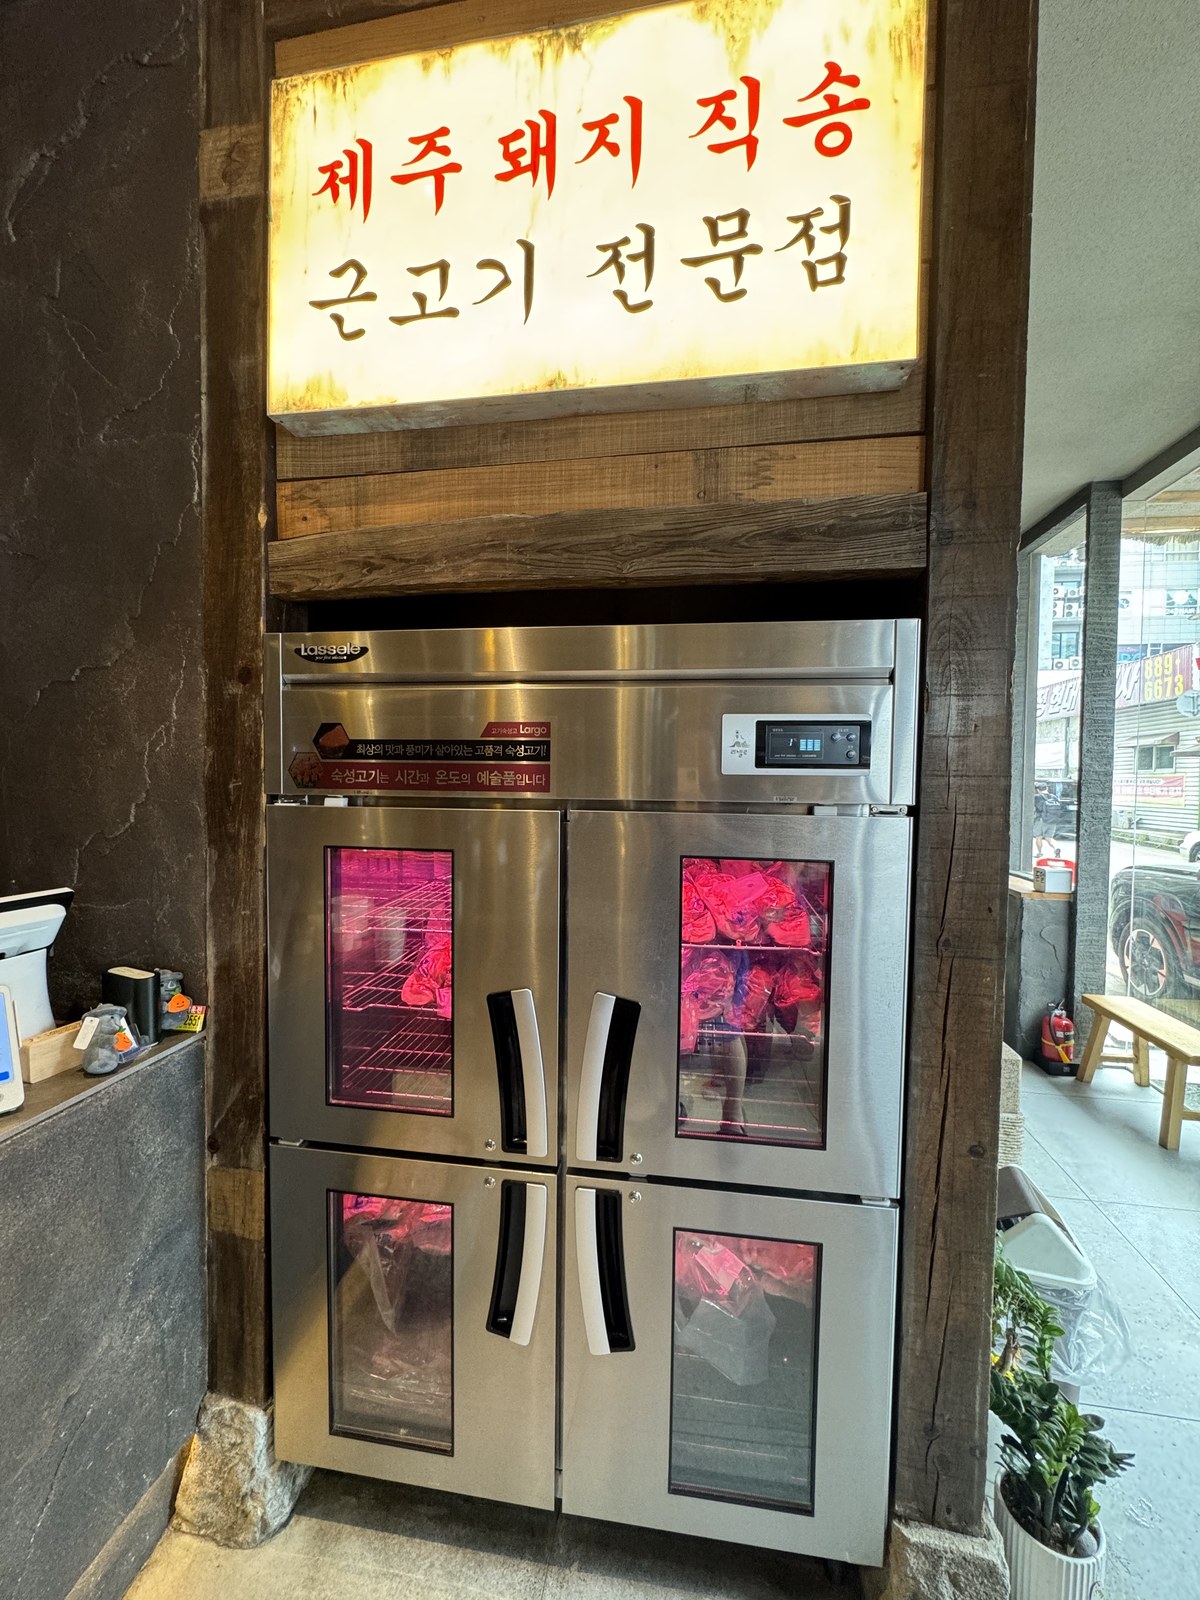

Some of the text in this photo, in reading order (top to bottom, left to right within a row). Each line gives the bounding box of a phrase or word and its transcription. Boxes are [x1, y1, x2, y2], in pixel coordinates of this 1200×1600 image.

[311, 61, 871, 223] 제주 돼지 직송
[308, 195, 852, 341] 근고기 전문점
[300, 642, 361, 656] Lassele
[1144, 674, 1184, 701] 6673
[520, 724, 547, 737] Largo
[356, 744, 547, 757] 최상의 맛과 풍미가 살아있는 고품격 숙성고기!
[330, 768, 546, 786] 숙성고기는 시간과 온도의 예술품입니다
